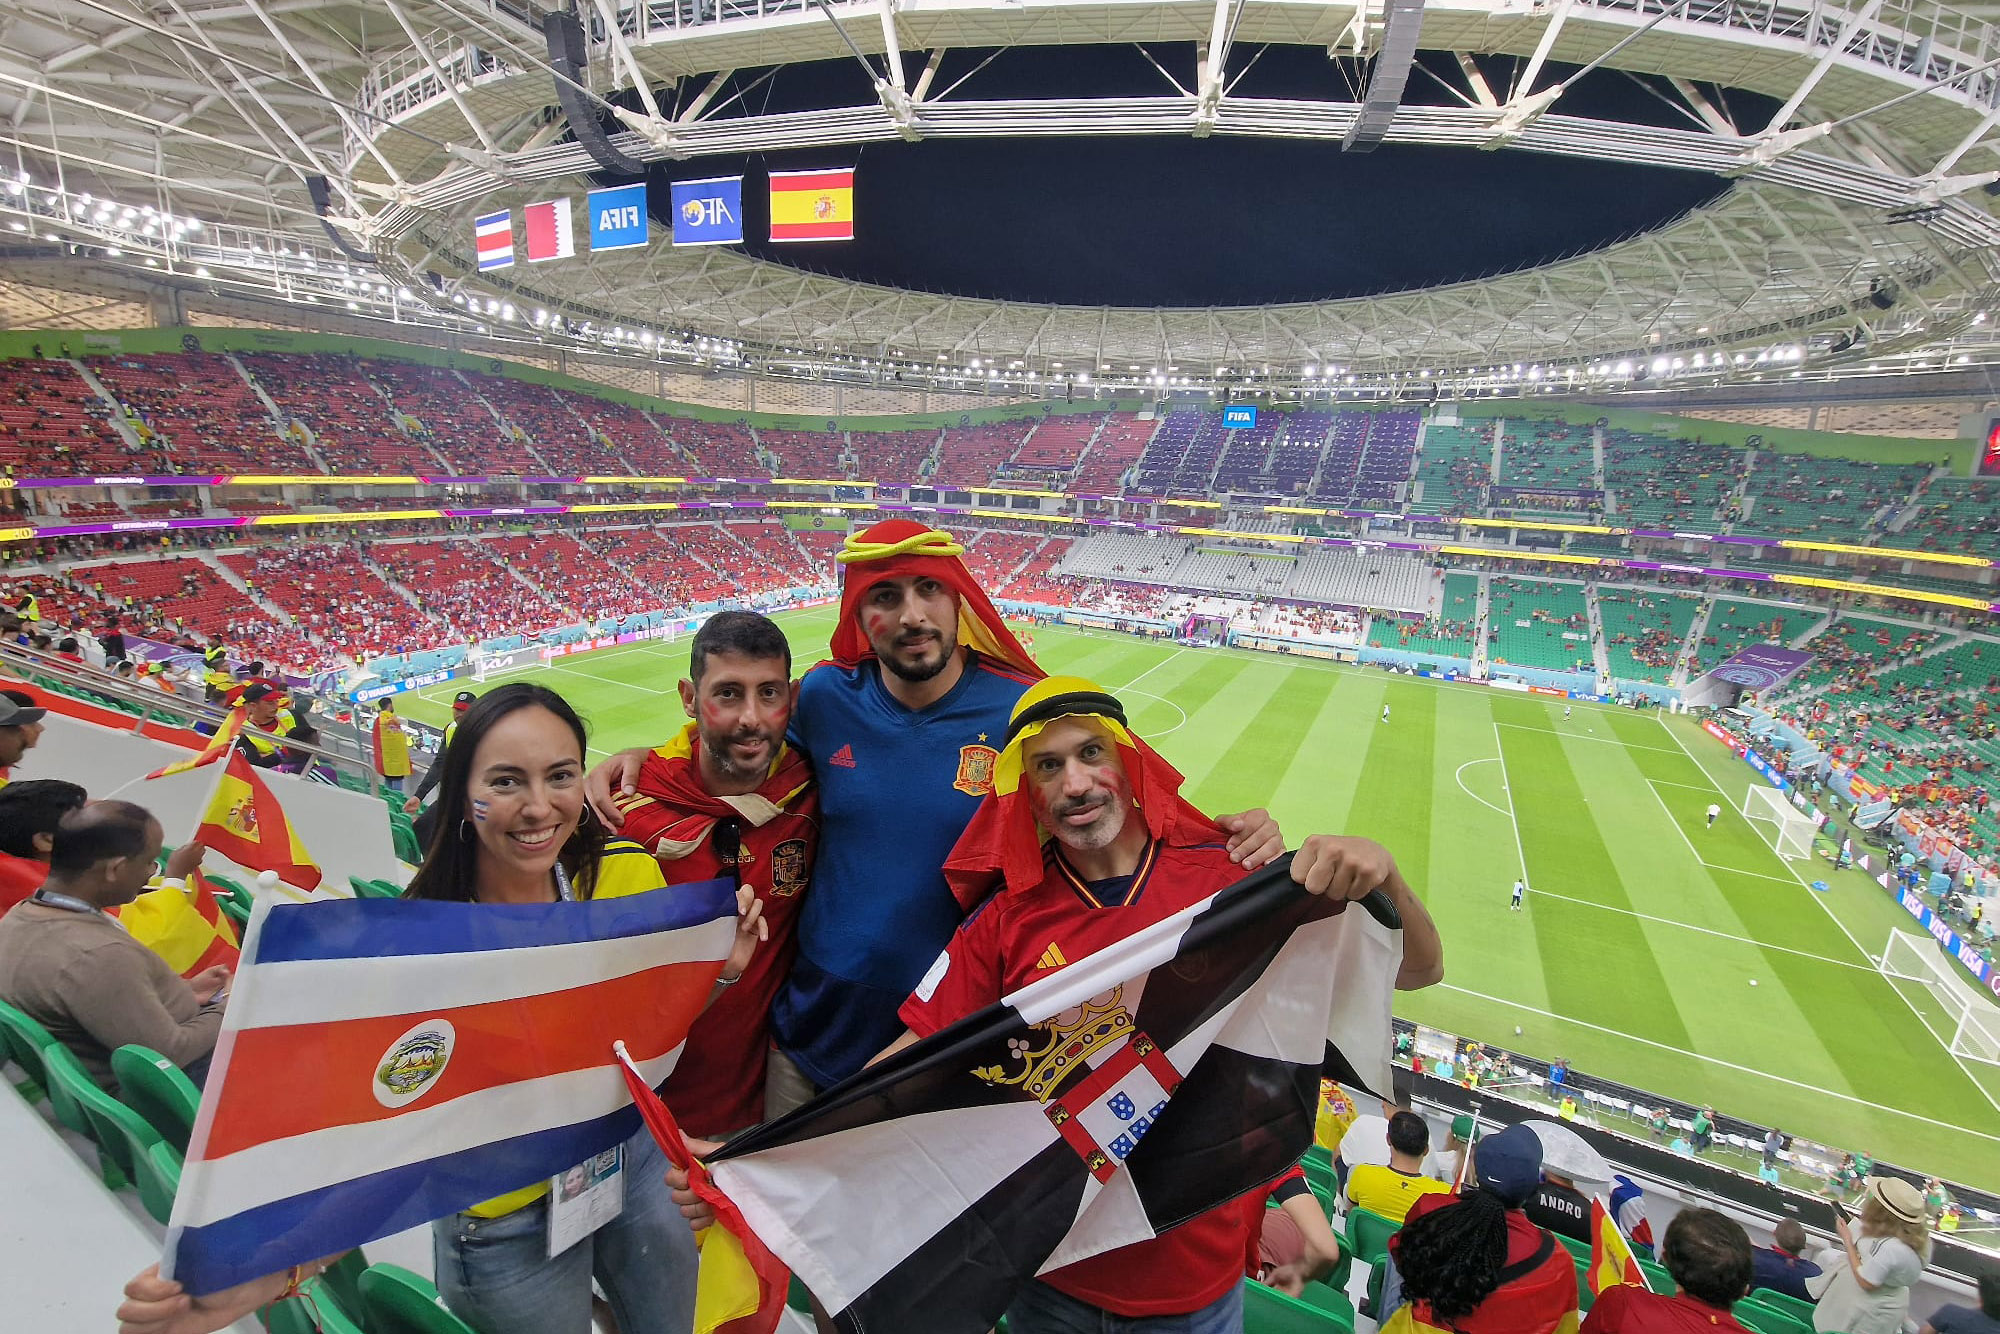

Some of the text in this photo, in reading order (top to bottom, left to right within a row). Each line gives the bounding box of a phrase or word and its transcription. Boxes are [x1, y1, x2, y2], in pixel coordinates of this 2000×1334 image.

[1227, 411, 1251, 421] FIFA
[367, 684, 398, 698] WANDA
[1575, 693, 1600, 702] vivo
[1902, 888, 1924, 920] VISA
[1928, 912, 1953, 947] VISA
[1958, 940, 1984, 977] VISA
[1540, 1193, 1582, 1219] ANDRO
